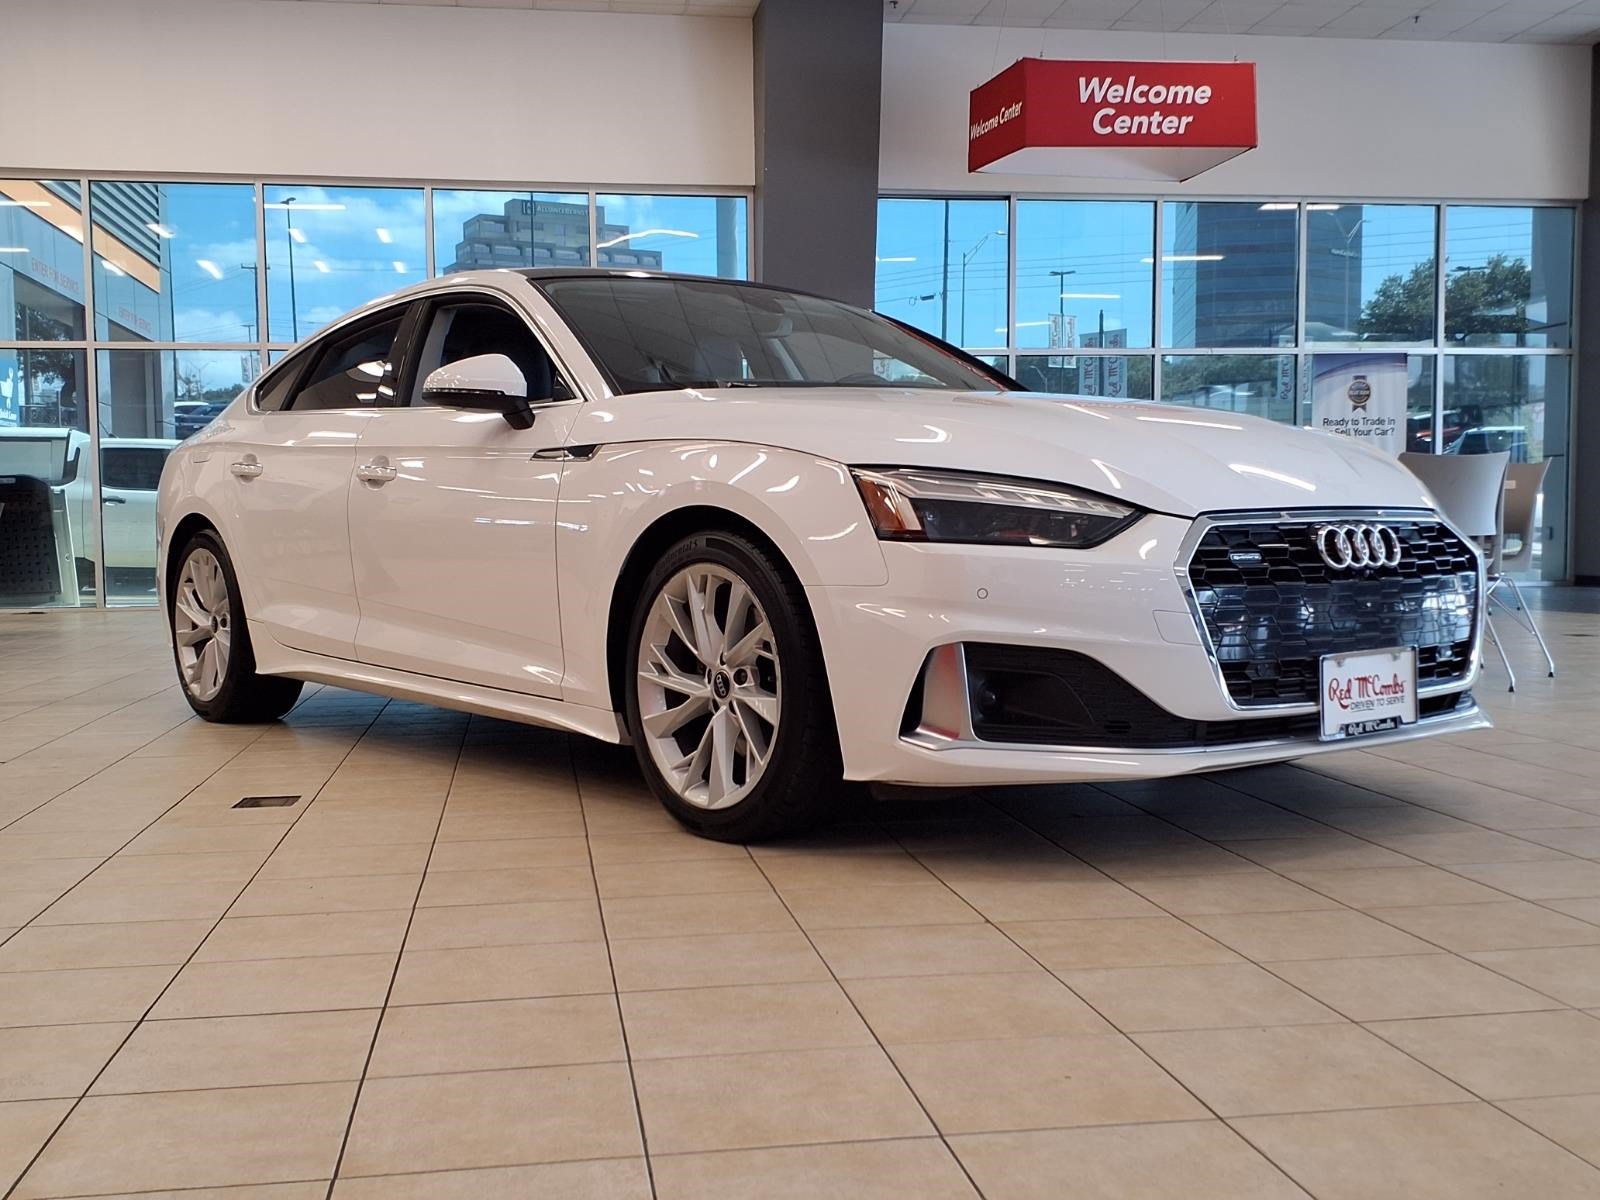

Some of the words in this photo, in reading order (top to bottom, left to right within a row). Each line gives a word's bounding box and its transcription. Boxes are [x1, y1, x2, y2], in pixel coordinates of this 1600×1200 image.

[1078, 75, 1212, 105] Welcome
[970, 115, 999, 141] Welcome
[999, 100, 1023, 126] Center
[1092, 107, 1194, 135] Center
[1322, 417, 1349, 427] Ready
[1351, 417, 1360, 426] to
[1361, 417, 1386, 426] Trade
[1334, 428, 1351, 436] Sell
[1352, 427, 1372, 436] Your
[1374, 427, 1395, 436] Car?
[1328, 678, 1353, 709] Red
[1353, 673, 1407, 698] McCombs
[1350, 700, 1375, 710] DRIVEN
[1376, 698, 1386, 707] TO
[1386, 696, 1405, 705] SERVE
[1348, 723, 1363, 735] Red
